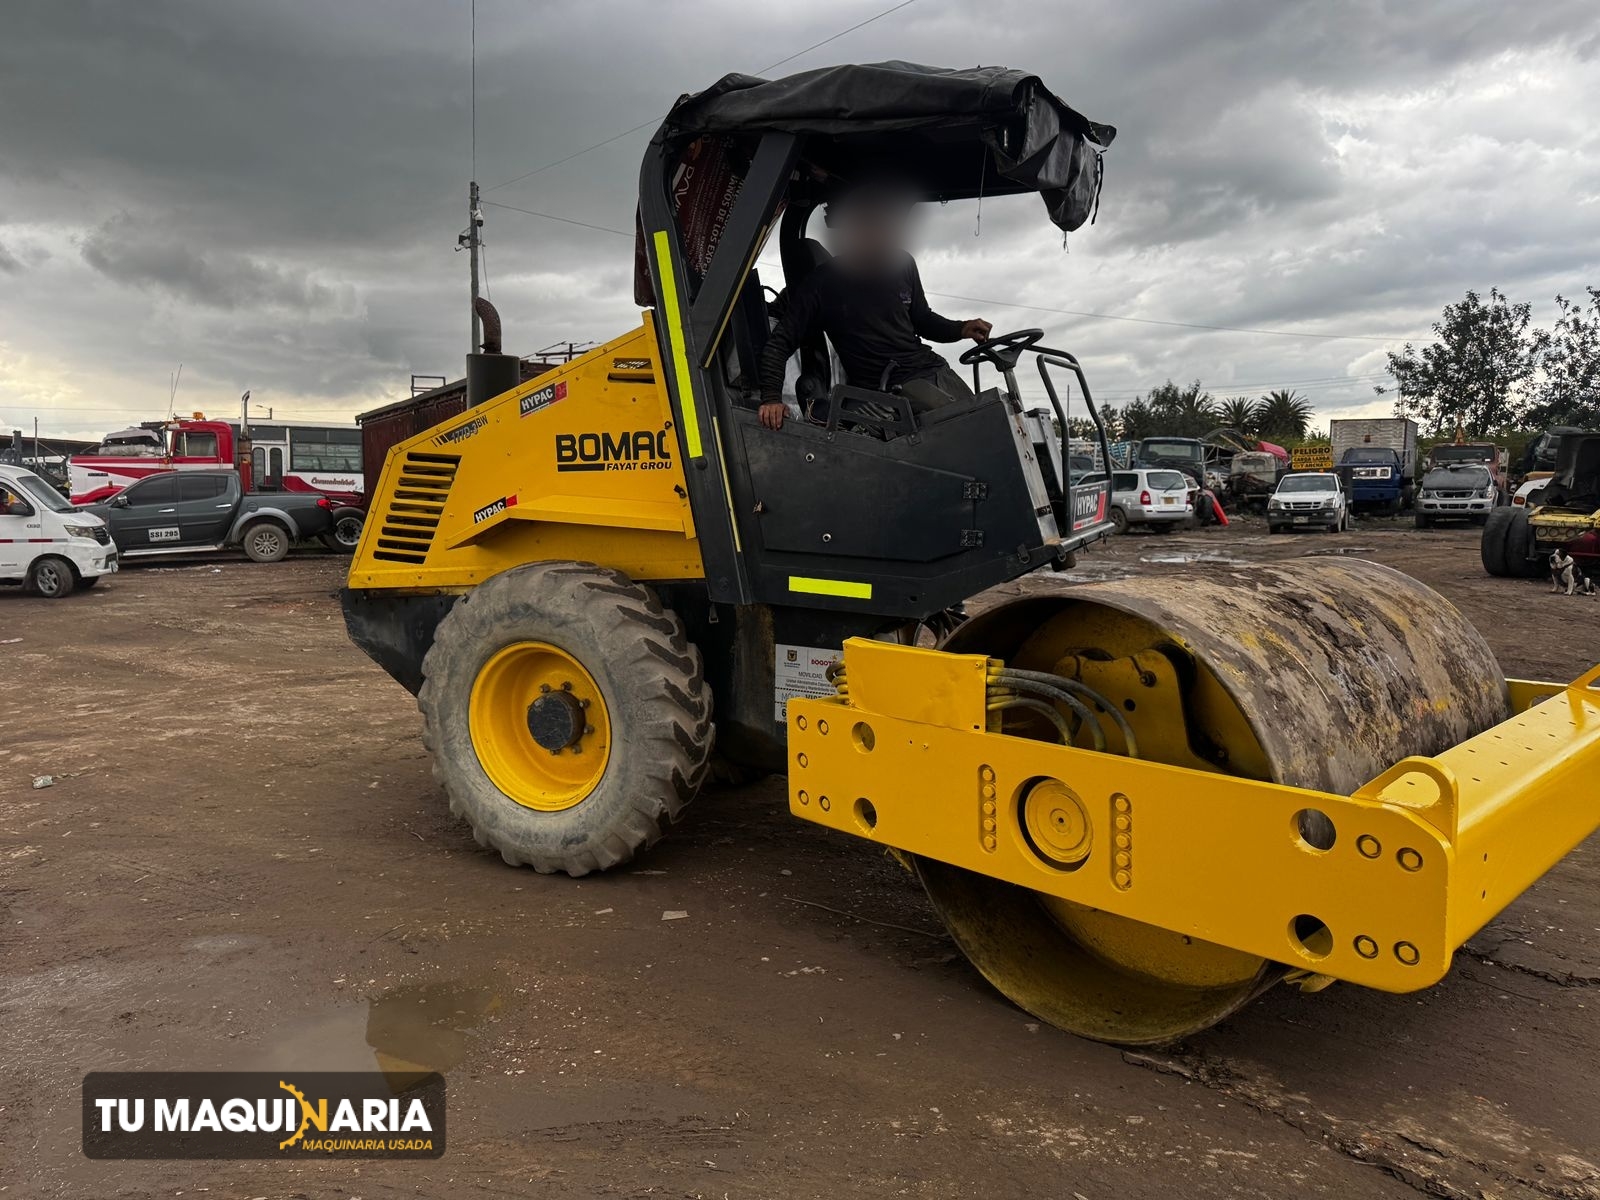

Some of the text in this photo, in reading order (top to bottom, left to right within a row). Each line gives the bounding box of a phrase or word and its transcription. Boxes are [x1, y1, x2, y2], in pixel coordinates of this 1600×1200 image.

[521, 388, 553, 410] HYPAC
[1293, 447, 1330, 455] PELIGRO
[606, 463, 638, 471] FAYAT
[475, 501, 505, 523] HYPAC
[1077, 494, 1098, 516] HYPAC
